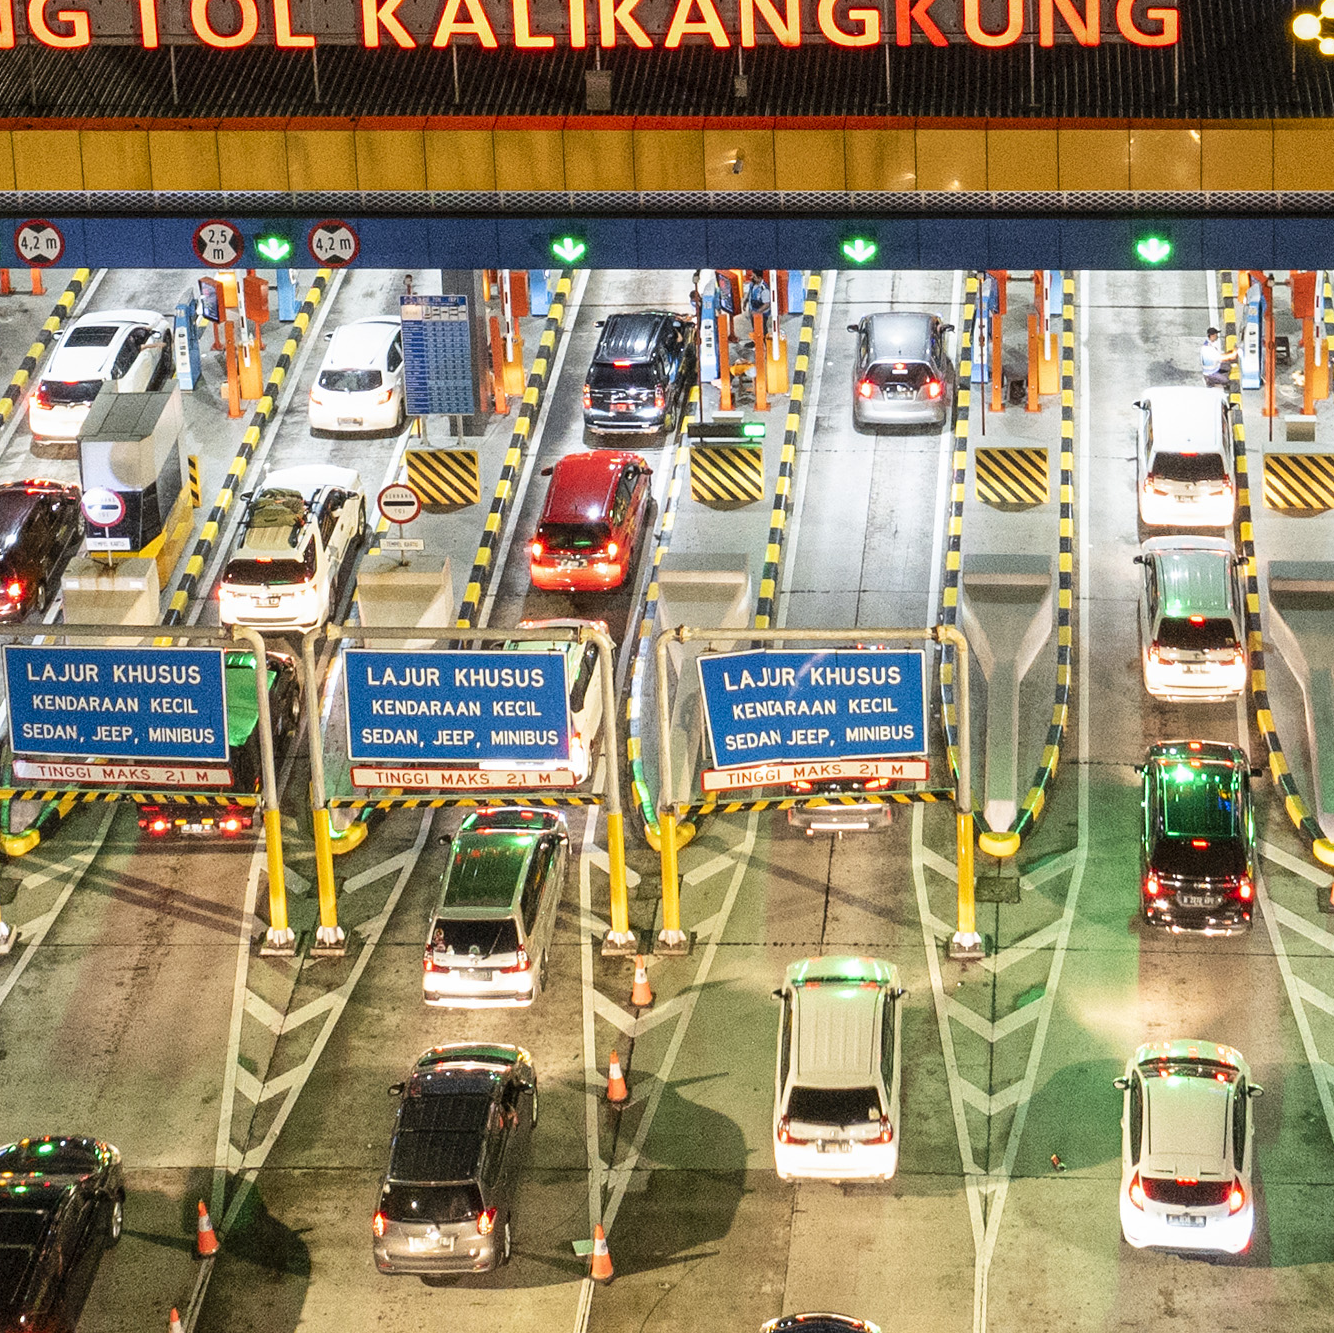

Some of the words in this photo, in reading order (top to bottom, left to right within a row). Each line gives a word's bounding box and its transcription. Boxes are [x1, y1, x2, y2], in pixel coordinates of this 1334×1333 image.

[21, 236, 39, 251] 4,2
[46, 238, 57, 249] m
[209, 230, 227, 245] 2,5
[316, 237, 335, 252] 4,2
[340, 239, 351, 249] m
[213, 249, 223, 259] m
[27, 663, 98, 682] LAJUR
[113, 665, 201, 684] KHUSUS
[368, 667, 440, 686] LAJUR
[455, 668, 544, 688] KHUSUS
[724, 668, 795, 690] LAJUR
[811, 666, 901, 686] KHUSUS
[33, 695, 139, 712] KENDARAAN
[151, 699, 198, 714] KECIL
[372, 700, 480, 716] KENDARAAN
[493, 701, 541, 716] KECIL
[849, 698, 898, 714] KECIL
[23, 724, 85, 743] SEDAN,
[92, 727, 139, 744] JEEP,
[149, 727, 214, 744] MINIBUS
[362, 729, 425, 748] SEDAN,
[433, 731, 481, 749] JEEP,
[491, 731, 558, 745] MINIBUS
[787, 729, 835, 746] JEEP,
[846, 725, 914, 742] MINIBUS
[38, 766, 91, 778] TINGGI
[166, 771, 185, 784] 2,1
[197, 772, 208, 782] M
[375, 772, 428, 784] TINGGI
[507, 773, 527, 786] 2,1
[539, 773, 551, 783] M
[727, 770, 780, 785] TINGGI
[859, 764, 879, 777] 2,1
[892, 765, 903, 775] M
